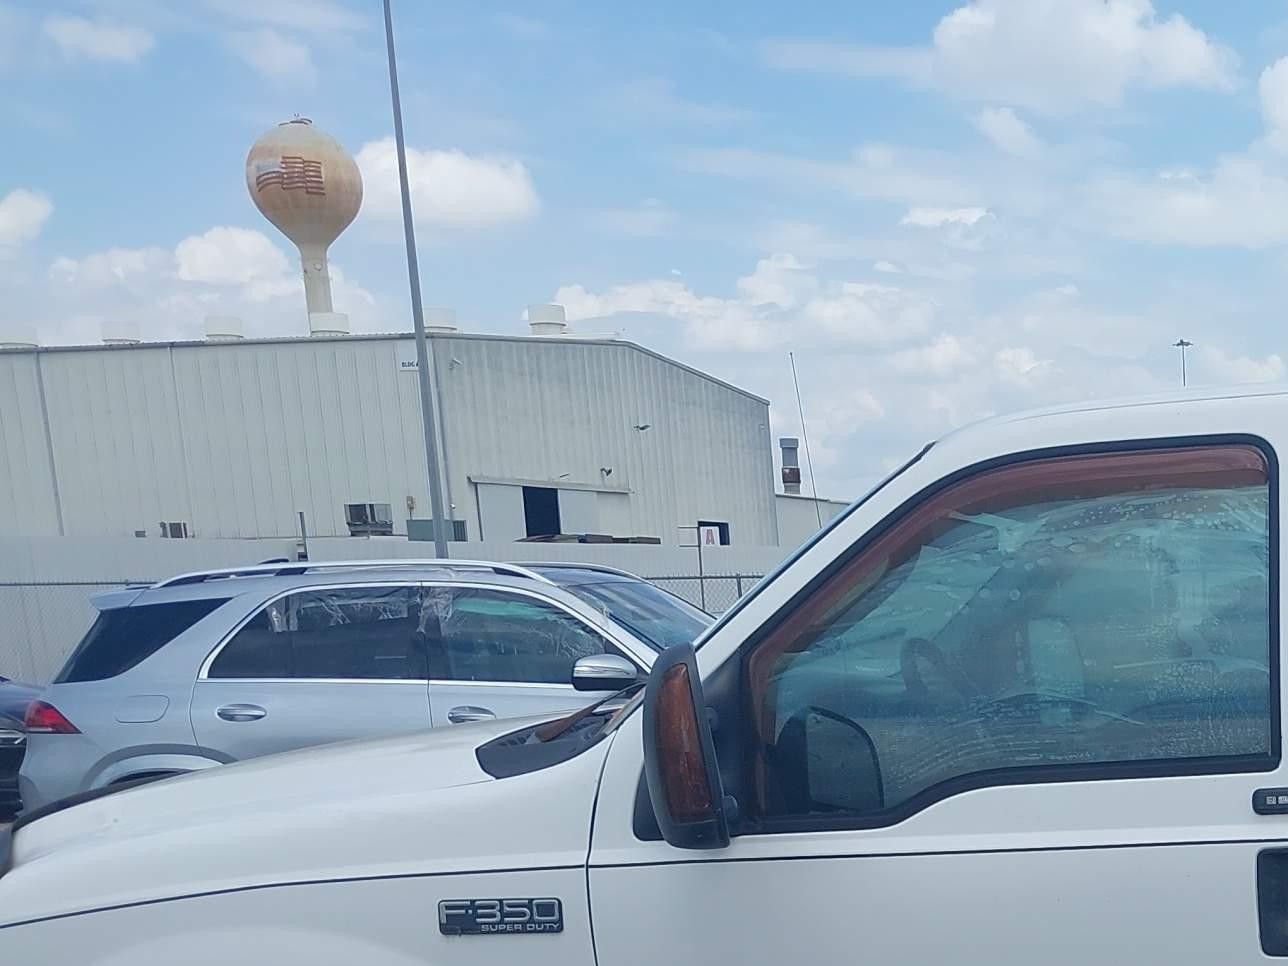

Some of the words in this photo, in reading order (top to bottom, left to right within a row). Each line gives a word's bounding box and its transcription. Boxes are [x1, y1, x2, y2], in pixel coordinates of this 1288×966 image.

[705, 529, 715, 545] A
[481, 924, 522, 932] SUPER
[526, 923, 560, 931] DUTY
